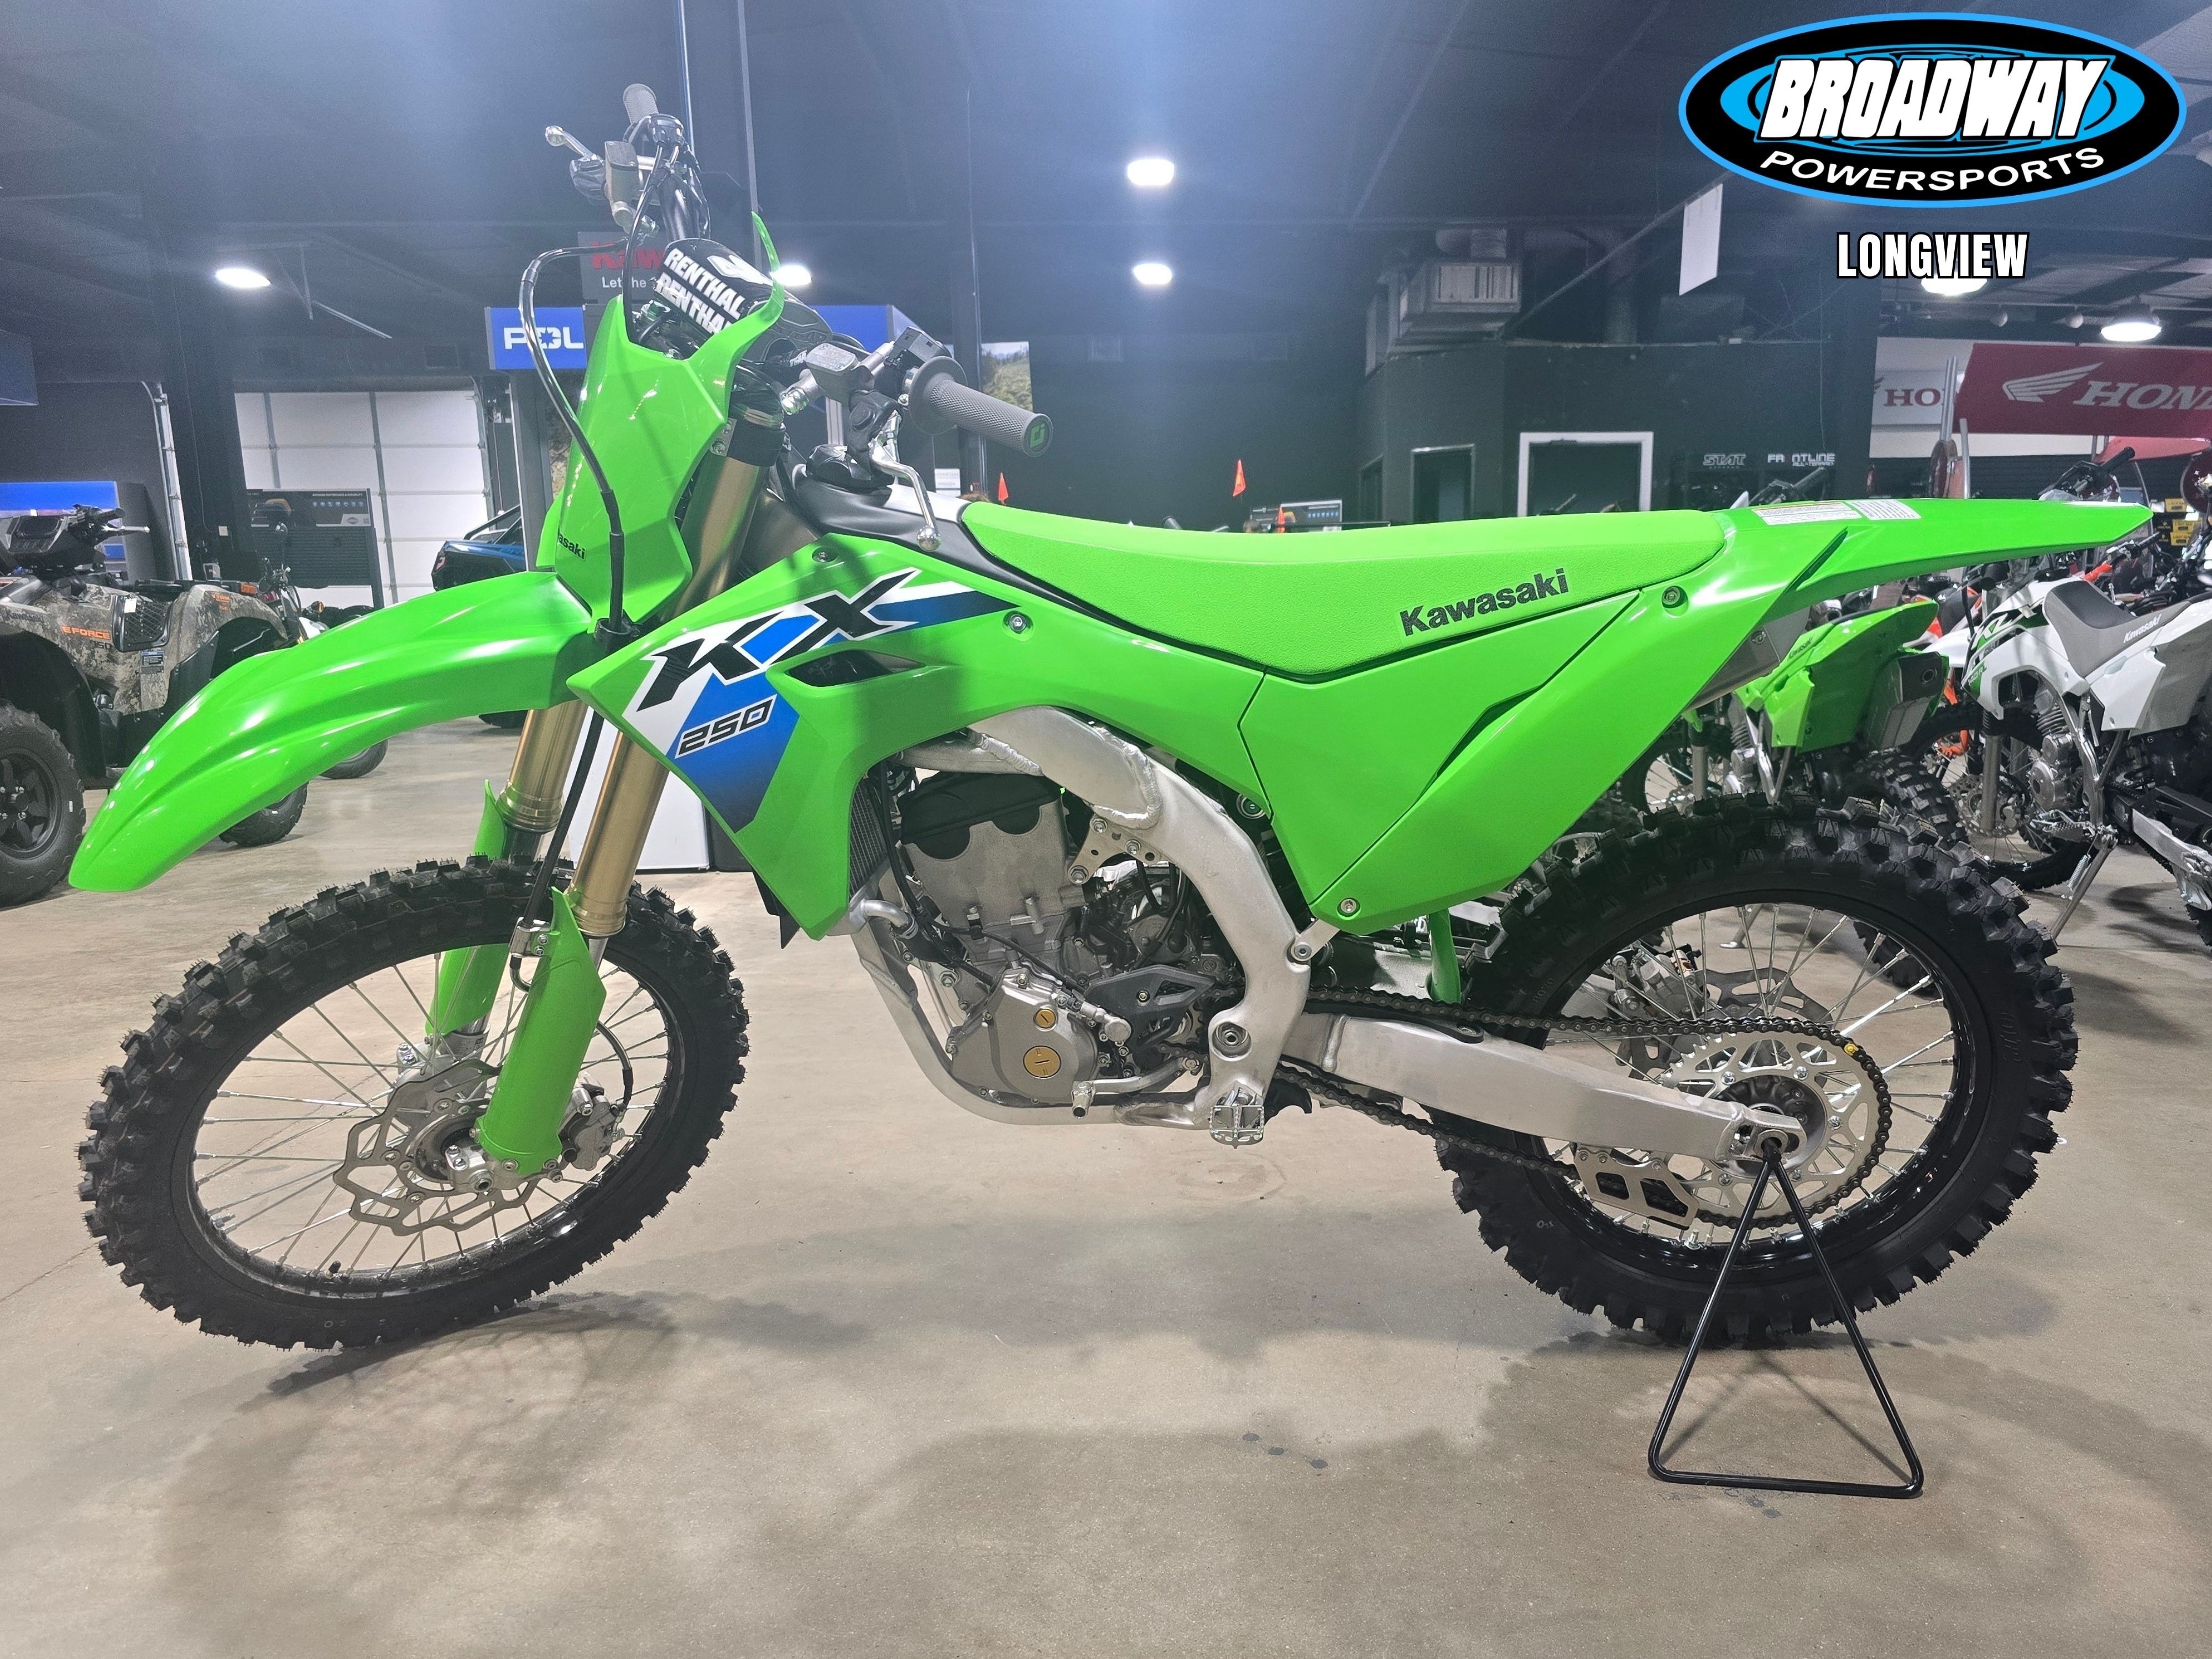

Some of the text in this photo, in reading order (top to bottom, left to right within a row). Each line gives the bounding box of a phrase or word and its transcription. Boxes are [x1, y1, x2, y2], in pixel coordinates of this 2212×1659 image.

[632, 276, 646, 288] he
[655, 272, 733, 333] RENTHA
[664, 248, 746, 320] RENTHAL
[1884, 388, 1944, 407] HO
[1399, 567, 1569, 637] Kawasaki
[2124, 613, 2162, 644] Kawasaki
[636, 570, 917, 713] KX
[677, 696, 775, 757] 250
